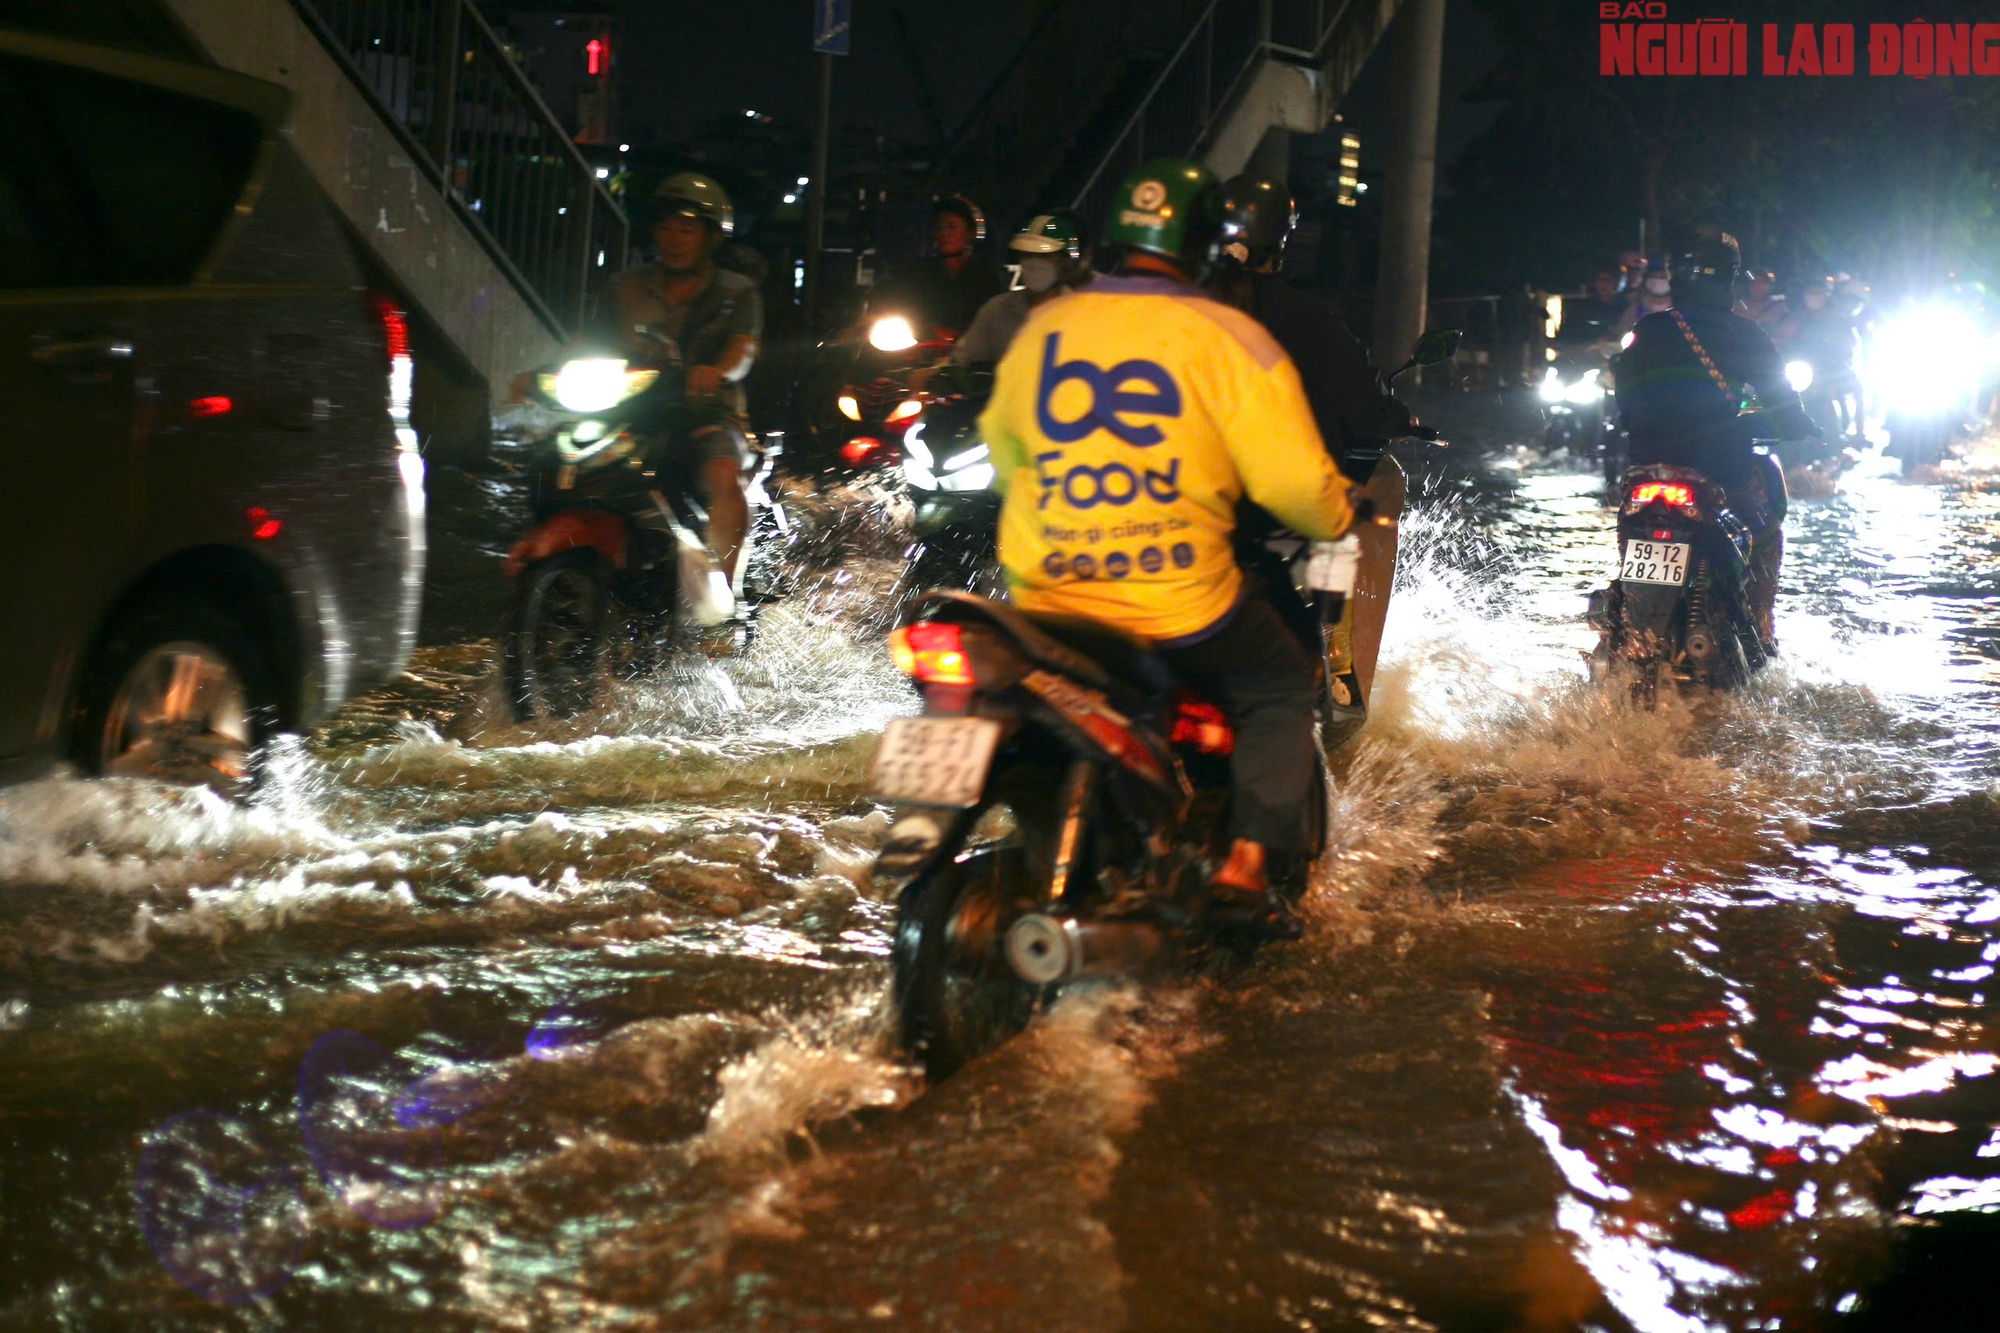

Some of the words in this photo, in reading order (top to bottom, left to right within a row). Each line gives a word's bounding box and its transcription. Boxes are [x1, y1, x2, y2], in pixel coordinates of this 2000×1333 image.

[1036, 331, 1183, 448] be
[1634, 542, 1681, 563] 59-T2
[1623, 561, 1683, 582] 282.16
